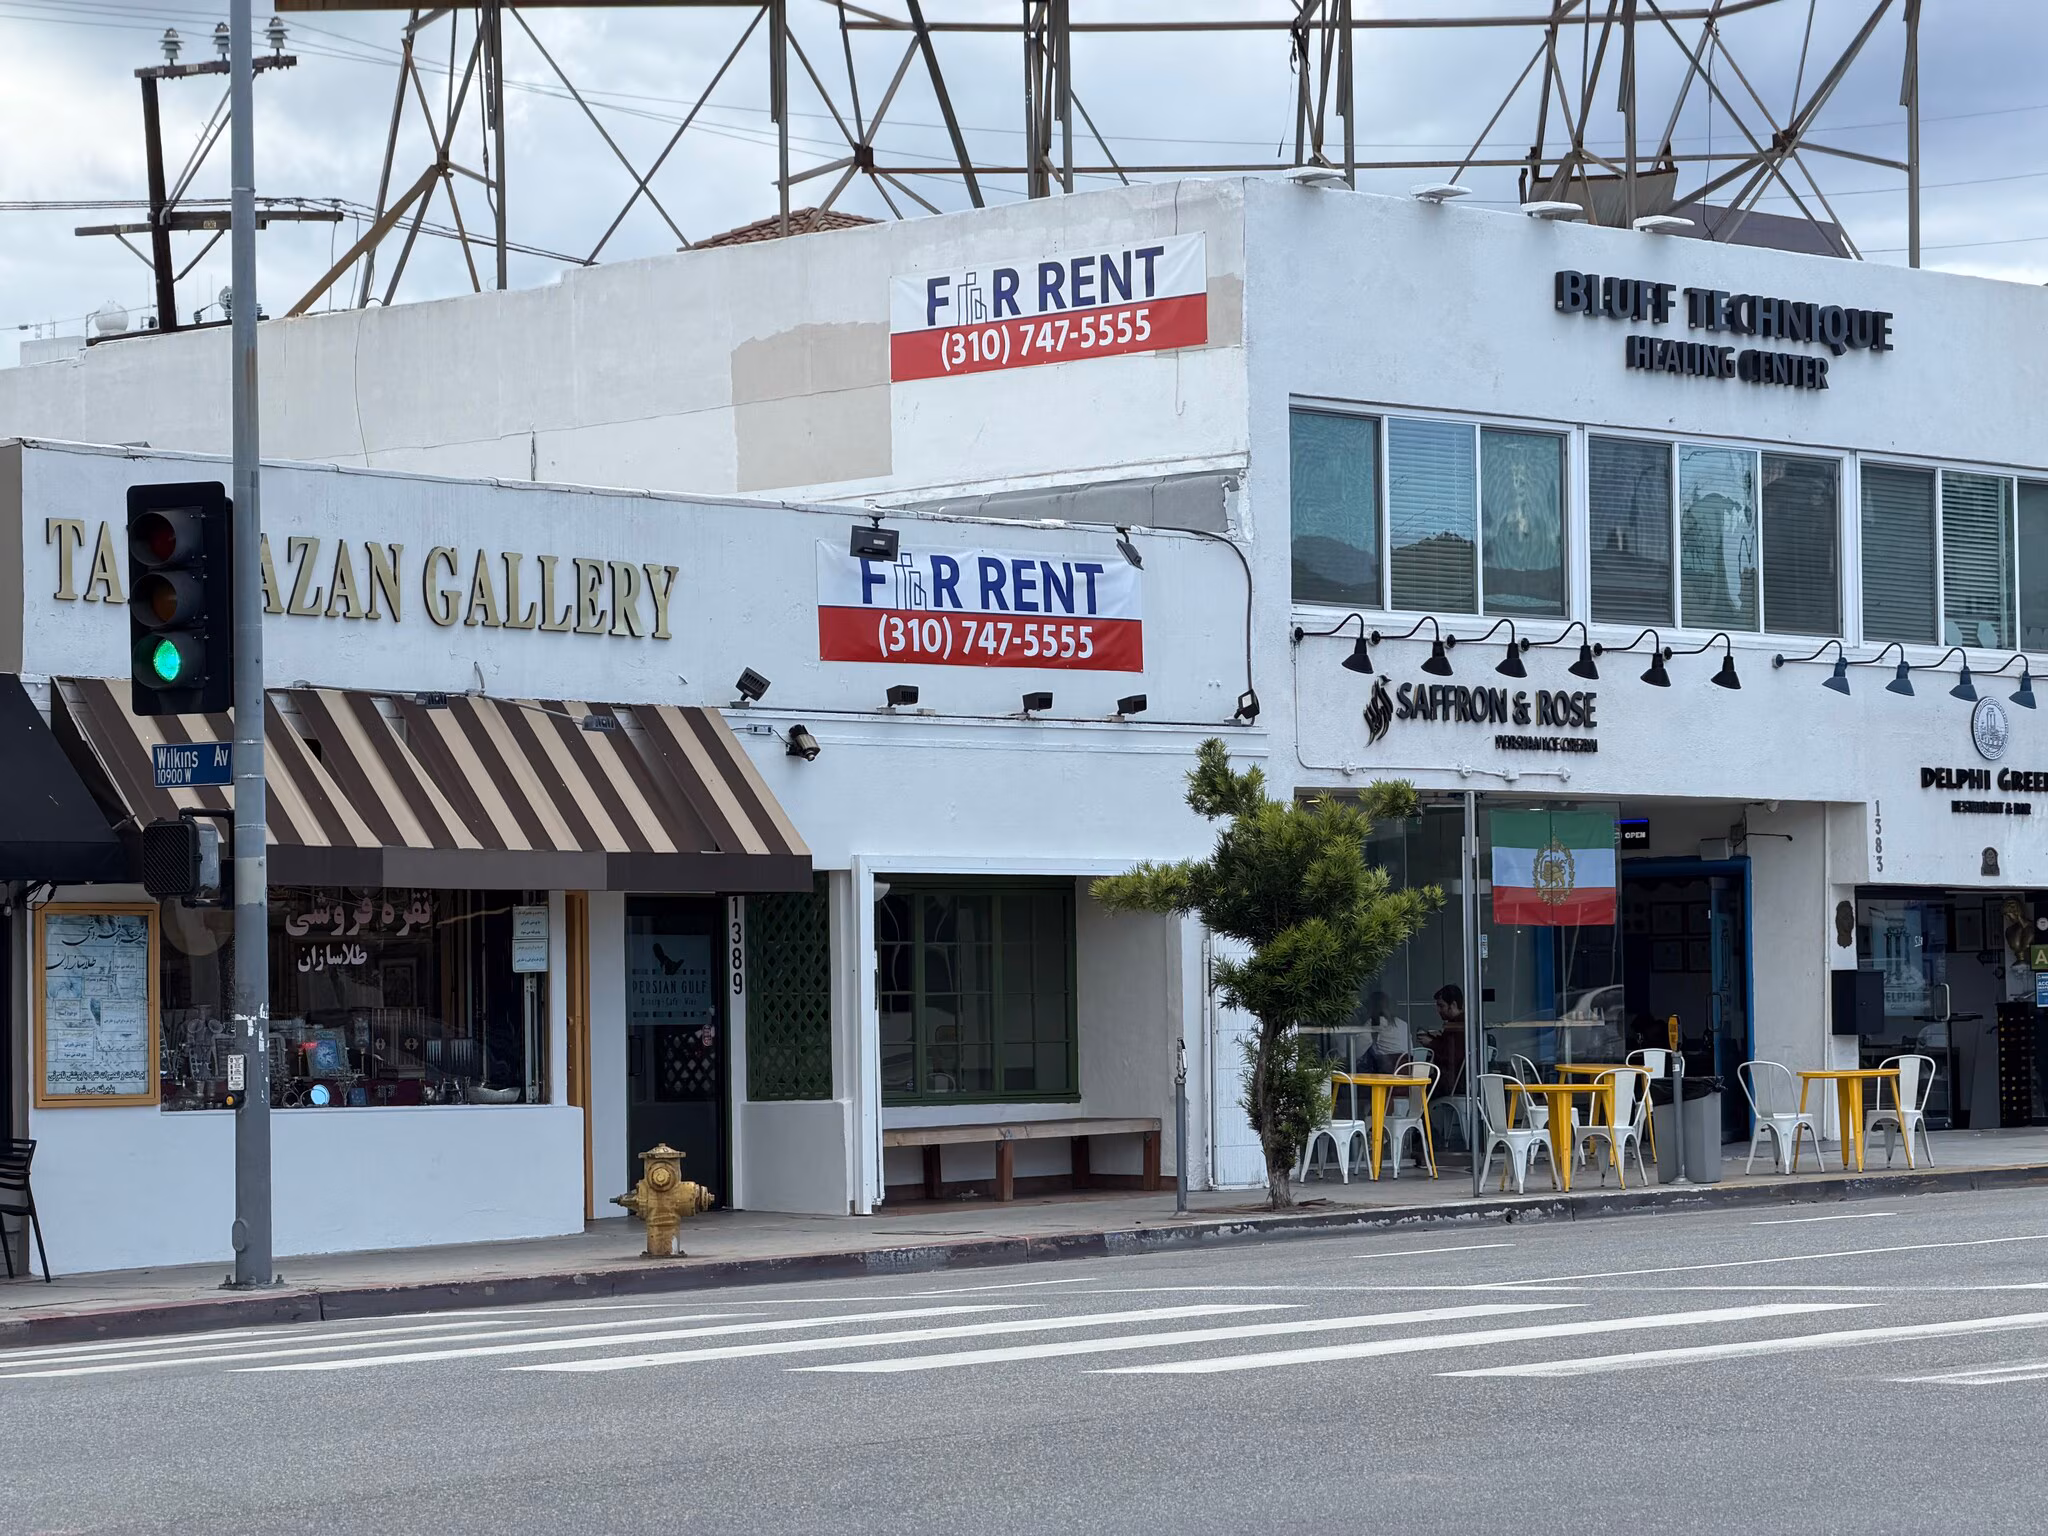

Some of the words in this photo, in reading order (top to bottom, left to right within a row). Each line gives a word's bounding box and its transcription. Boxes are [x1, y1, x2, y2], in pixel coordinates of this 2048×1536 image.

[1038, 245, 1165, 312] RENT
[1555, 270, 1677, 323] BLUFF
[1683, 287, 1894, 356] TECHNIQUE
[941, 324, 1010, 372] (310)
[1019, 308, 1151, 357] 747-5555
[1625, 335, 1736, 378] HEALING
[1737, 348, 1829, 390] CENTER
[422, 545, 679, 639] GALLERY
[977, 556, 1104, 615] RENT
[878, 613, 952, 660] (310)
[961, 620, 1093, 659] 747-5555
[1396, 682, 1508, 724] SAFFRON
[1512, 691, 1531, 725] &
[1535, 690, 1597, 728] ROSE
[157, 747, 199, 768] Wilkins
[214, 745, 228, 767] Av
[1495, 735, 1541, 751] PERSIAN
[158, 769, 182, 784] 10900
[185, 768, 192, 783] W
[1920, 767, 1991, 790] DELPHI
[1624, 831, 1646, 839] OPEN
[1874, 800, 1884, 873] 1383
[285, 887, 374, 937] فروشی
[381, 890, 433, 937] نقره
[732, 896, 743, 995] 1389
[632, 980, 676, 994] PERSIAN
[681, 980, 707, 994] GULF
[1885, 992, 1915, 1003] ELPHI
